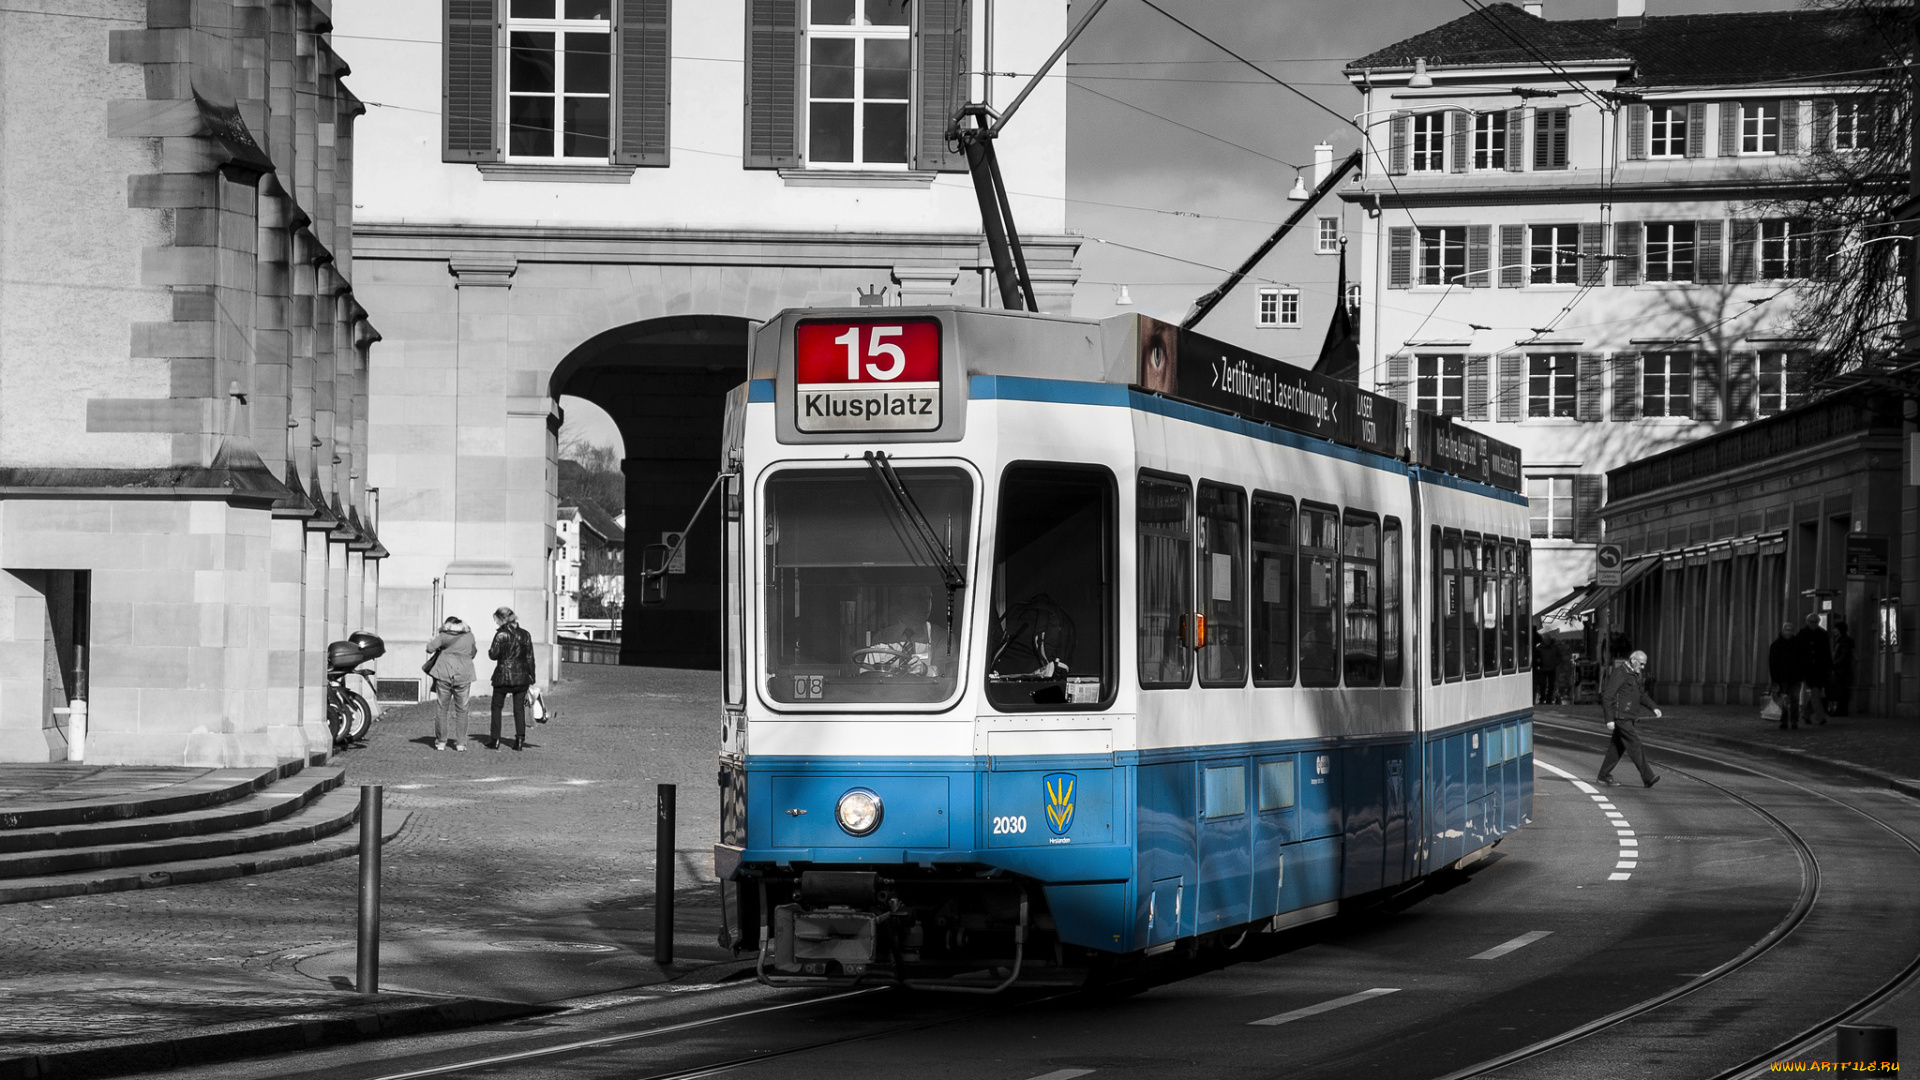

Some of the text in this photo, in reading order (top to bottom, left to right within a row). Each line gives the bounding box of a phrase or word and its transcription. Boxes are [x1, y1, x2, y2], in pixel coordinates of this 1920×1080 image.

[835, 326, 906, 381] 15
[1221, 356, 1330, 428] Zertifizierte Laserchirurgie.
[806, 393, 933, 421] Klusplatz
[1356, 393, 1373, 419] LASER
[796, 678, 822, 695] 08
[993, 815, 1027, 835] 2030
